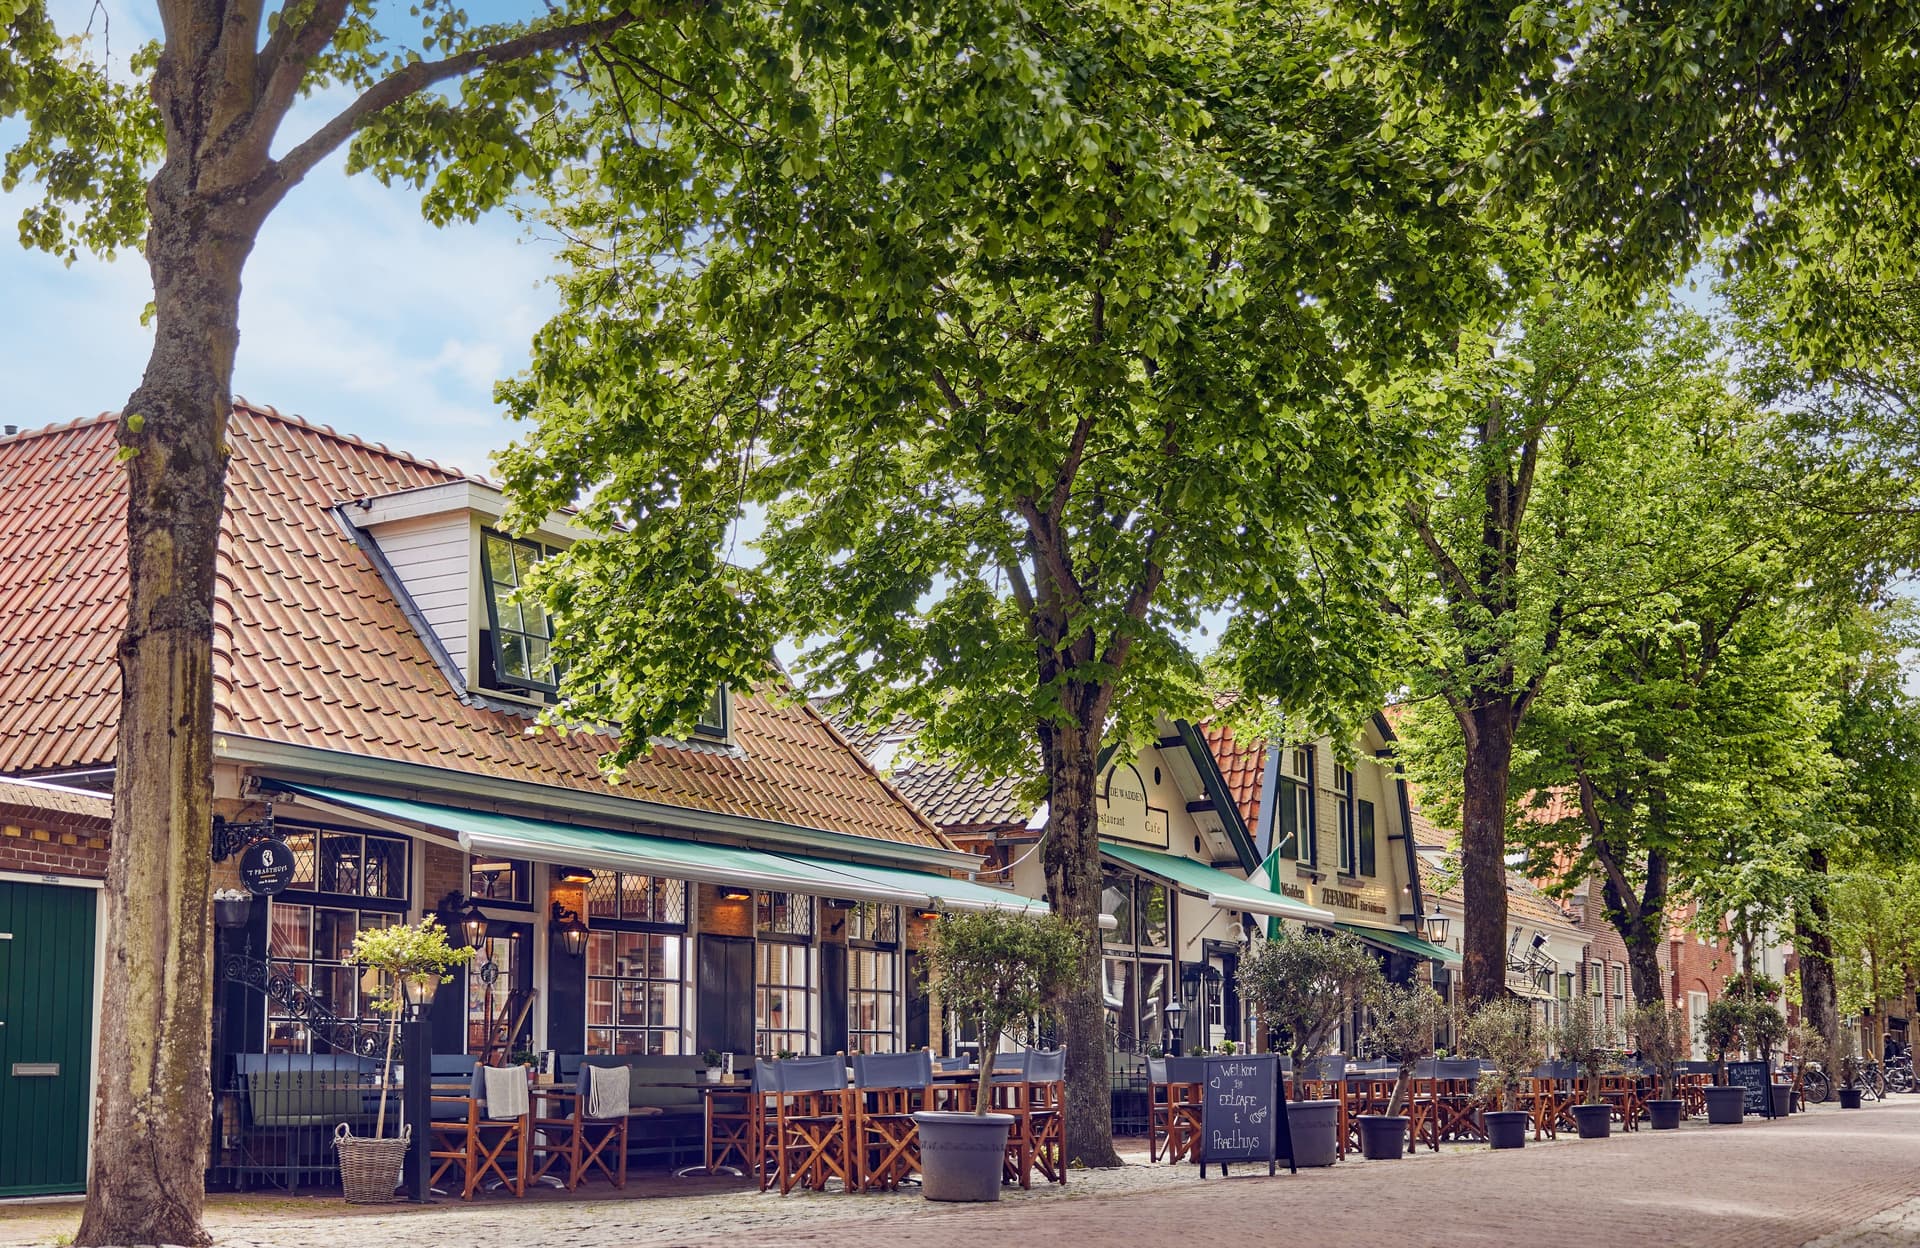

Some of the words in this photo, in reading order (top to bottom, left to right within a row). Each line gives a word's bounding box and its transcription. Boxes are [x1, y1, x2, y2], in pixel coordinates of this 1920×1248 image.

[1110, 787, 1119, 798] DE
[1119, 789, 1144, 802] WADDEN
[1098, 813, 1125, 826] estaurant
[1281, 882, 1304, 899] Wadden
